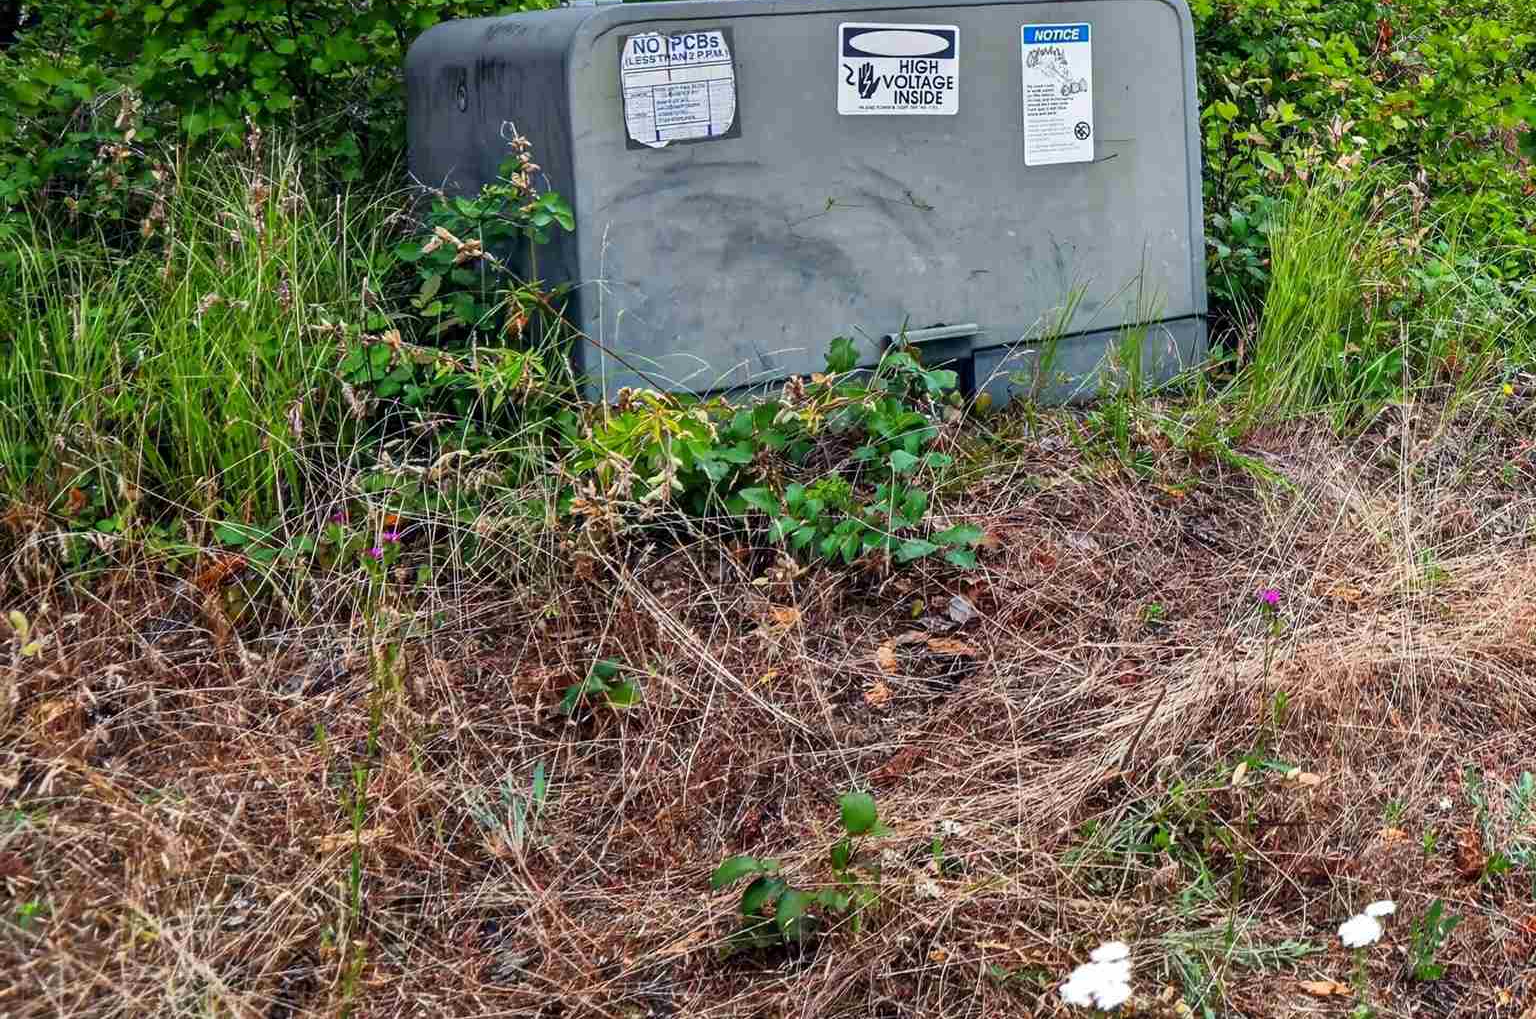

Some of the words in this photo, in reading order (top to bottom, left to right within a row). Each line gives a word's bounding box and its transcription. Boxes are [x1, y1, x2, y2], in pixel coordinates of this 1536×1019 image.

[1034, 28, 1080, 40] NOTICE
[633, 38, 660, 54] NO
[671, 34, 720, 51] PCBs
[625, 55, 656, 67] (LESS
[899, 60, 939, 74] HIGH
[882, 75, 954, 90] VOLTAGE
[894, 91, 943, 105] INSIDE
